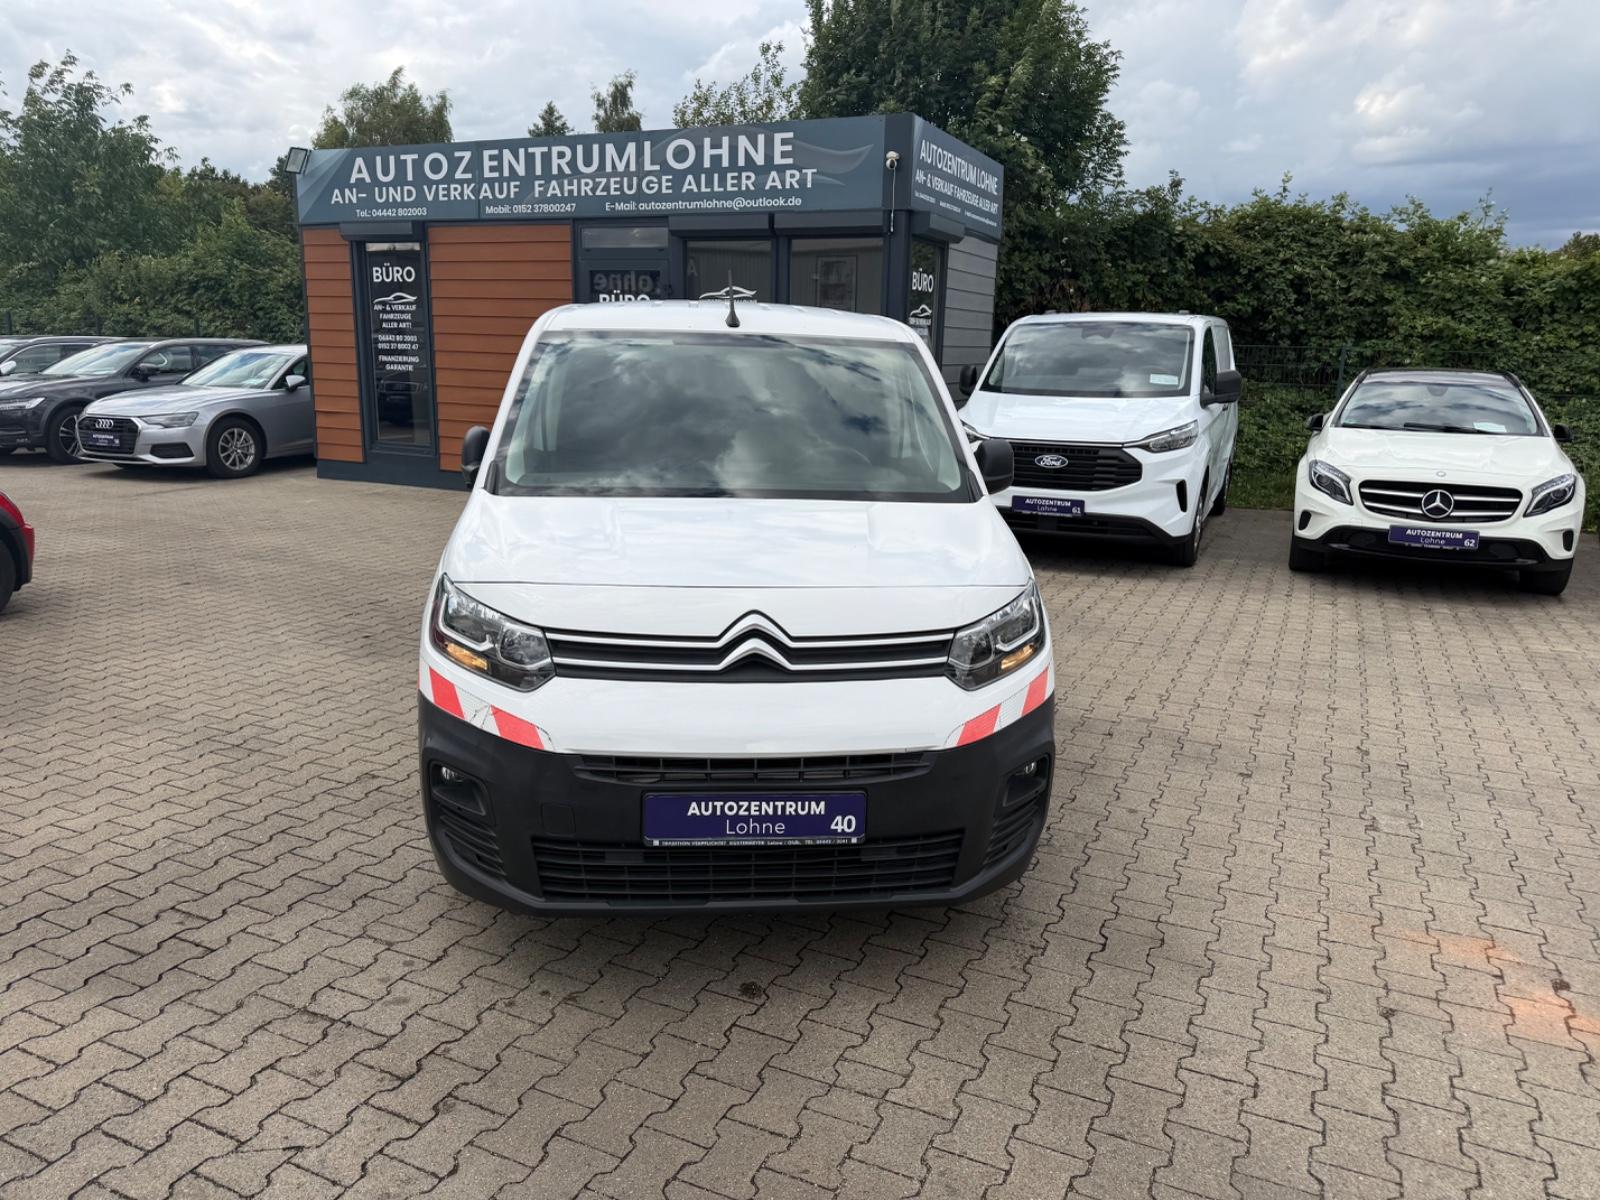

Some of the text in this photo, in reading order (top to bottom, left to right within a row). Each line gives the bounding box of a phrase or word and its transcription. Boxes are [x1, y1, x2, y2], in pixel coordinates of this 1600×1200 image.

[920, 140, 998, 195] AUTOZENTRUM LOHNE
[331, 168, 817, 205] AN- UND VERKAUF FAHRZEUGE ALLER ART
[485, 203, 576, 214] Mobil: 0152 37800247
[605, 196, 802, 211] E-Mail: autozentrumlohne@outlook.de
[372, 208, 396, 217] 04442
[398, 207, 427, 216] 802003
[372, 263, 416, 282] BÜRO
[911, 268, 934, 292] BÜRO
[1025, 498, 1071, 507] AUTOZENTRUM
[1406, 529, 1463, 539] AUTOZENTRUM
[1420, 537, 1446, 545] Lohne
[1464, 538, 1476, 547] 62
[687, 801, 826, 816] AUTOZENTRUM
[726, 818, 786, 835] Lohne
[830, 815, 857, 833] 40
